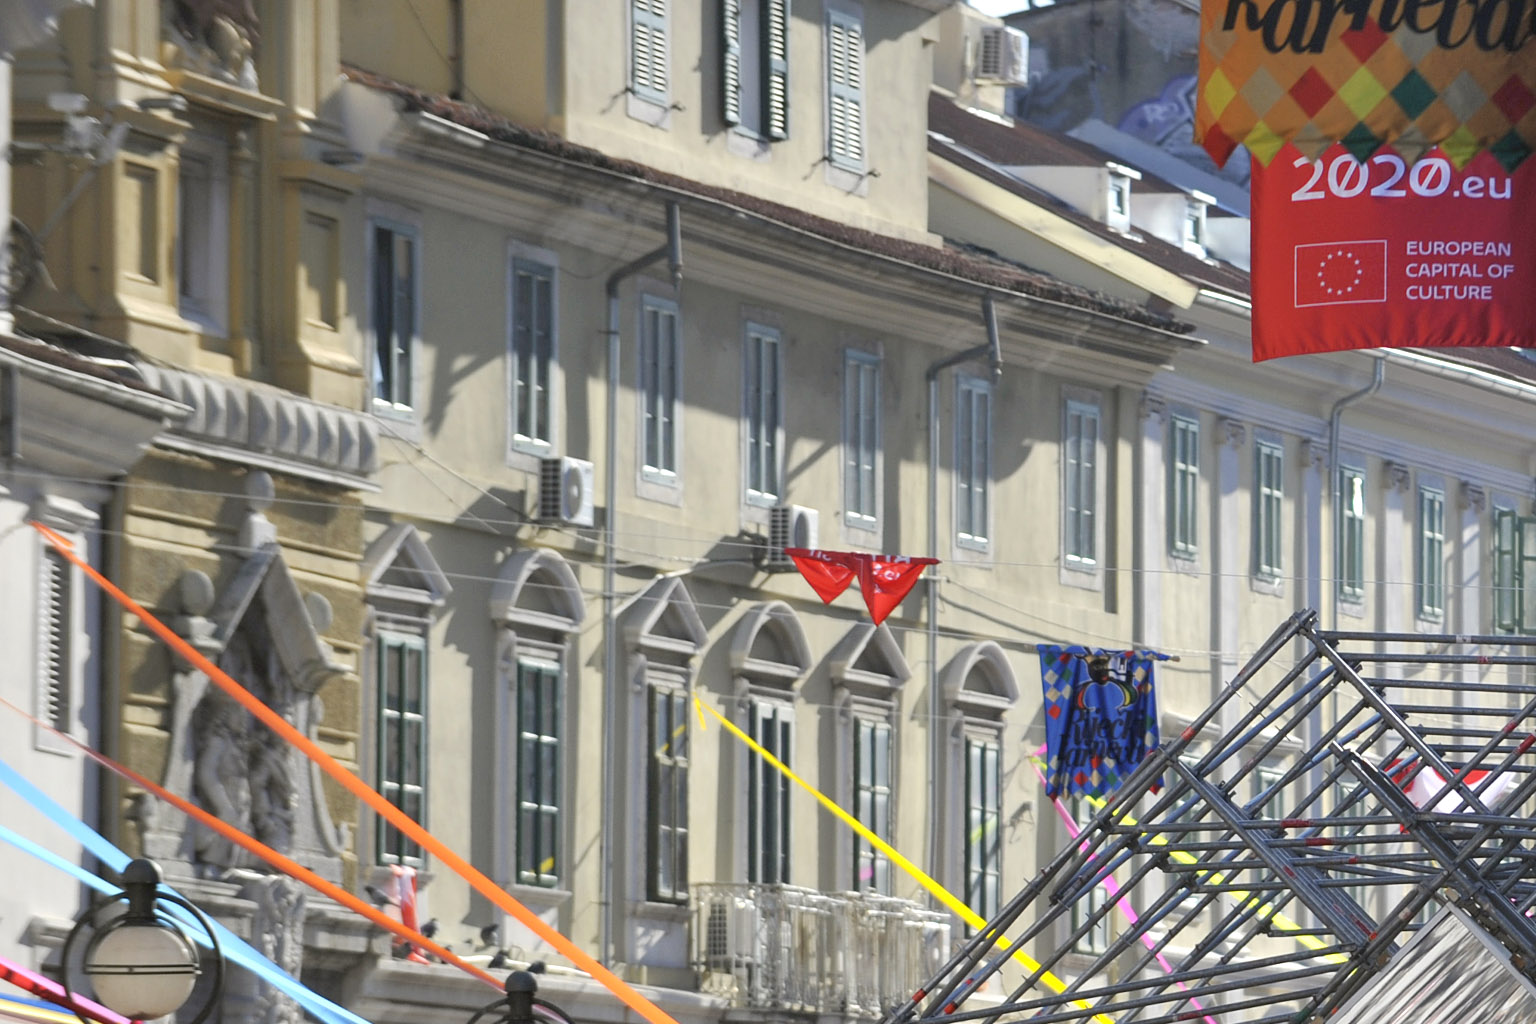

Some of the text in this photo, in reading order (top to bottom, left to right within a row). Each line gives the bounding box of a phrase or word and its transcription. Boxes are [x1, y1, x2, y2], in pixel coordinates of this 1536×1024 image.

[1291, 153, 1512, 202] 2020.eu
[1406, 241, 1511, 257] EUROPEAN
[1405, 263, 1514, 279] CAPITAL OF
[1405, 285, 1492, 300] CULTURE
